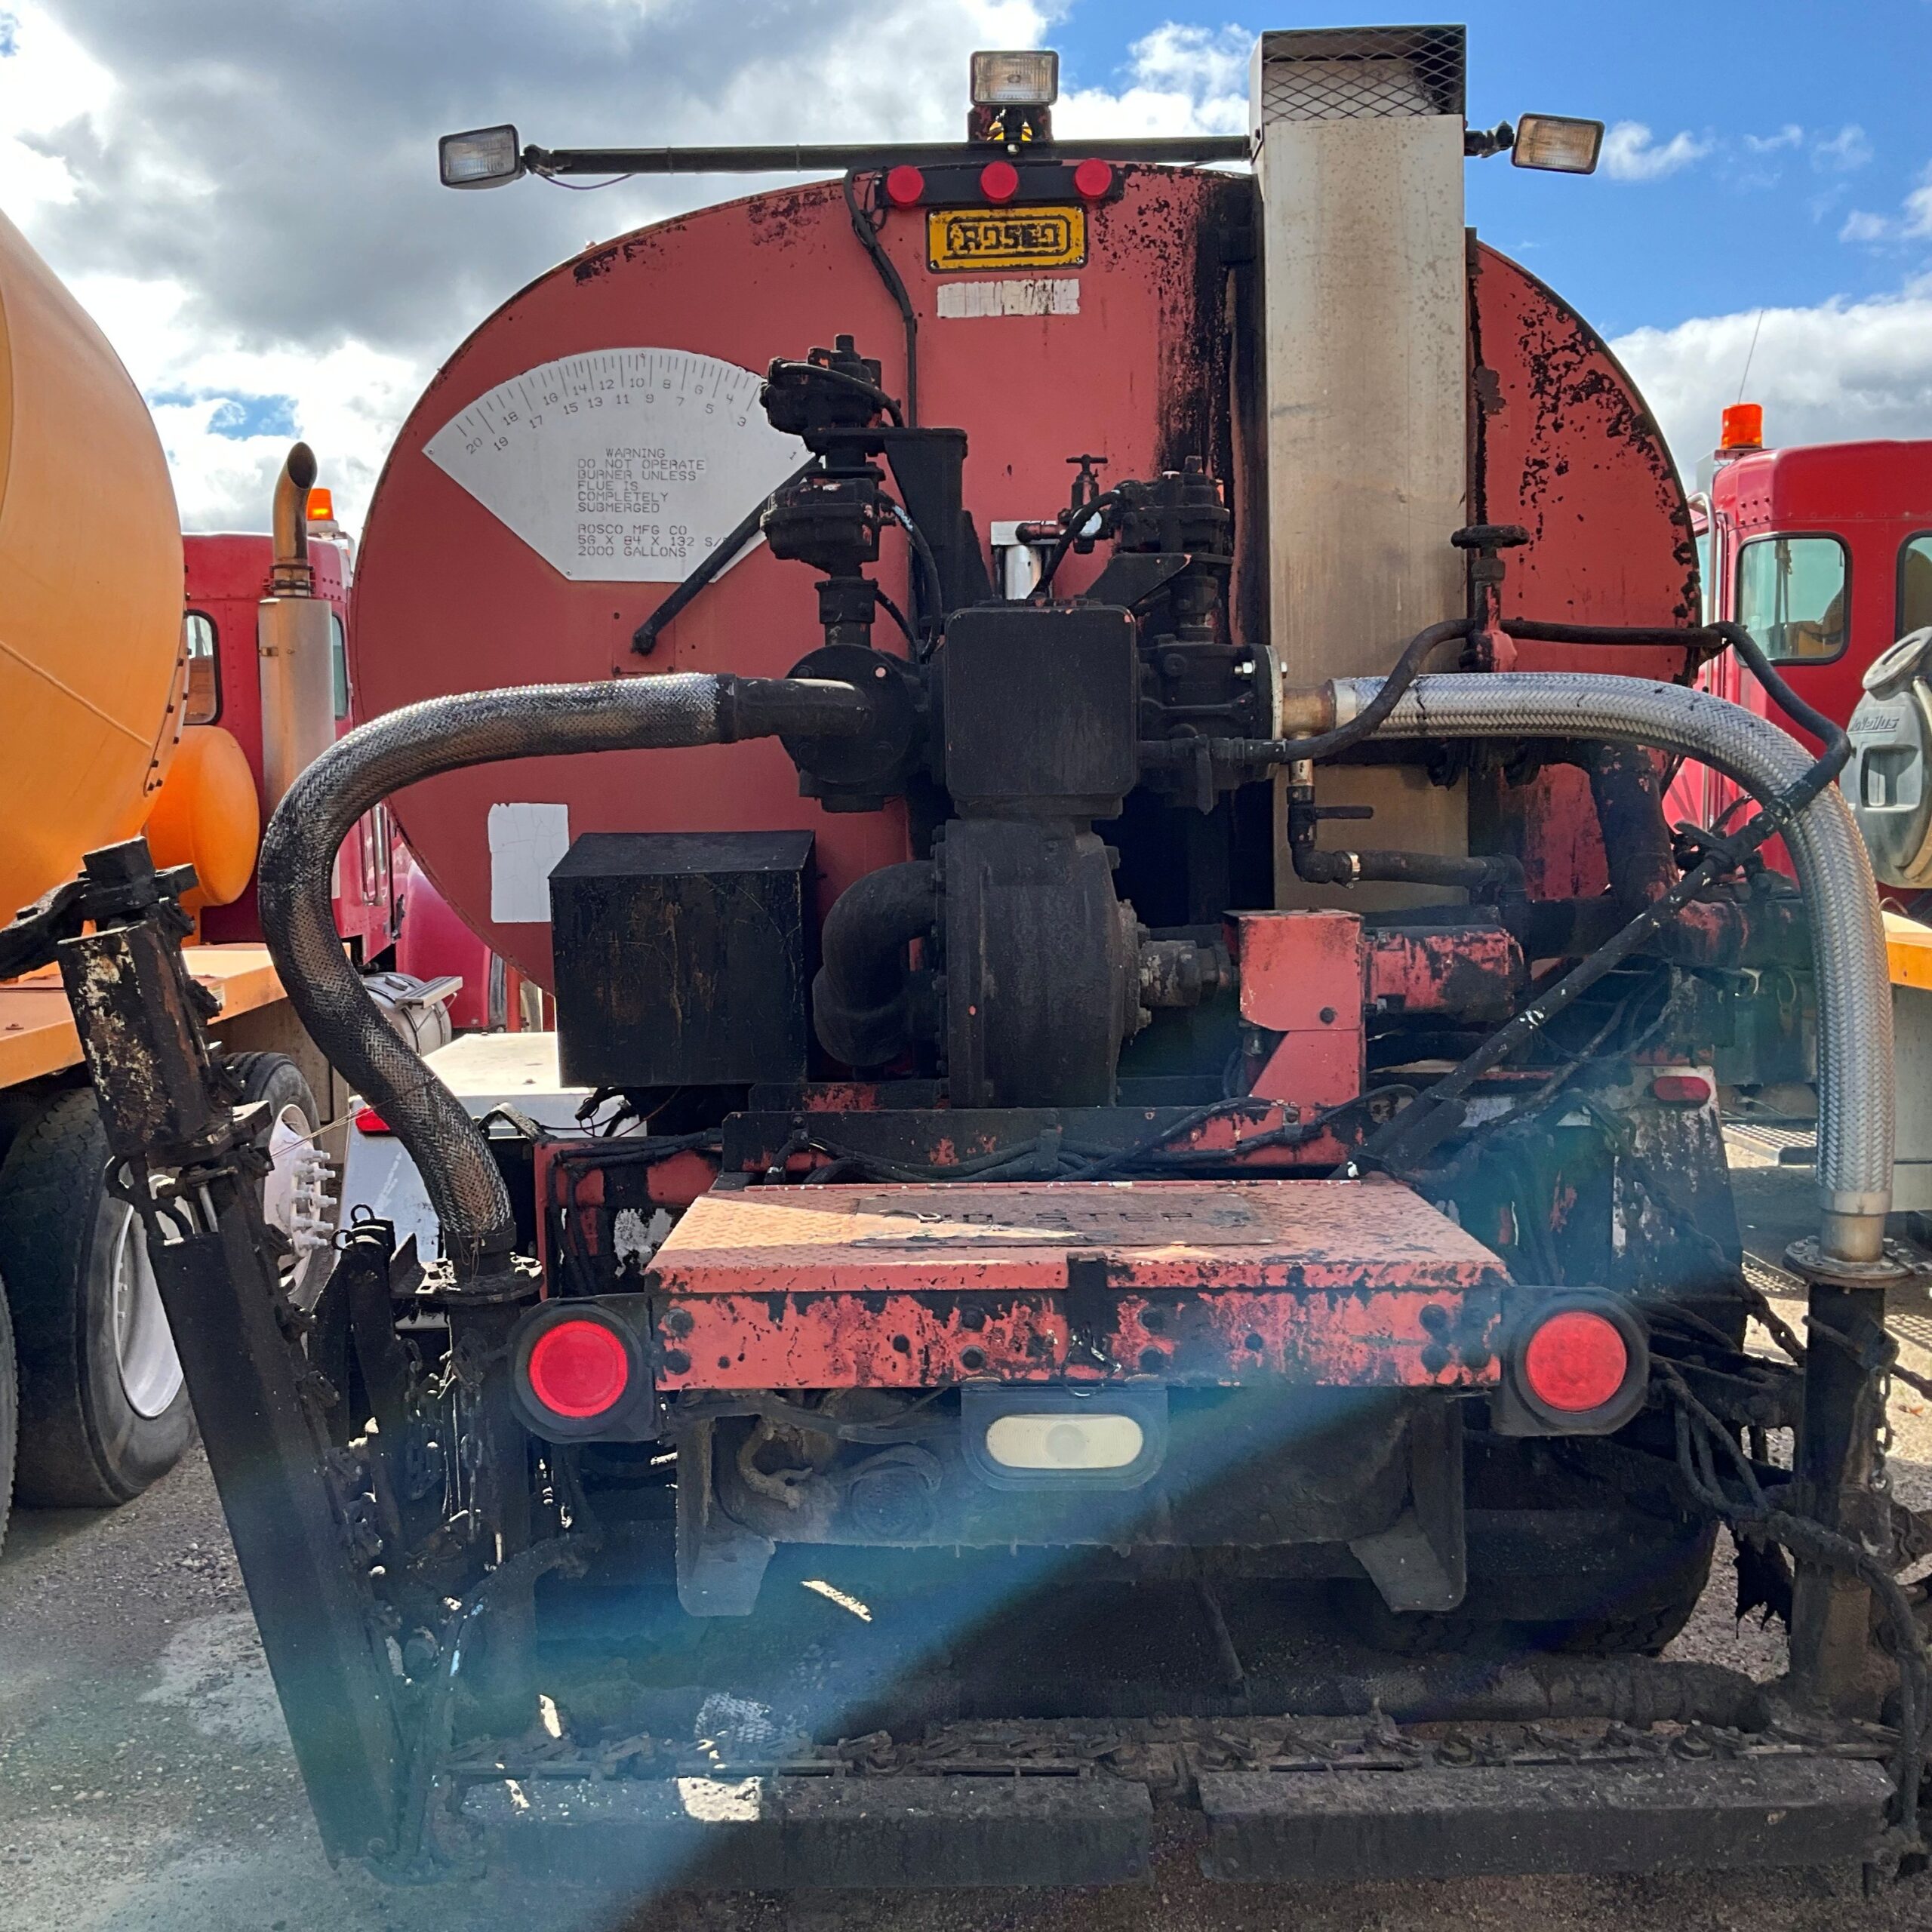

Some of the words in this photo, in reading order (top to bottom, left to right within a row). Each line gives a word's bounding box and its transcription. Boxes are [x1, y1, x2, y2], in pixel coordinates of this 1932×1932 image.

[599, 379, 615, 391] 12
[629, 378, 645, 388] 10
[663, 379, 671, 389] 8
[574, 383, 587, 396] 14
[588, 396, 603, 409] 13
[616, 394, 629, 405] 11
[645, 393, 654, 404] 9
[676, 396, 685, 406] 7
[726, 393, 734, 405] 4
[563, 402, 579, 415] 15
[705, 403, 714, 414] 5
[503, 411, 519, 426] 18
[529, 415, 543, 429] 17
[737, 417, 747, 427] 3
[466, 437, 484, 454] 20
[494, 436, 509, 451] 19
[605, 448, 666, 459] WARNING
[577, 459, 595, 469] DO
[605, 459, 632, 469] NOT
[641, 460, 706, 470] OPERATE
[577, 469, 632, 480] BURNER
[642, 470, 697, 481] UNLESS
[577, 481, 614, 491] FLUE
[623, 481, 638, 491] IS
[577, 491, 669, 502] COMPLETELY
[577, 503, 660, 513] SUBMERGED
[577, 524, 623, 534] ROSCO
[632, 525, 660, 535] MFG
[669, 525, 688, 535] CO
[605, 535, 614, 545] X
[651, 536, 660, 546] X
[671, 537, 695, 546] 132
[577, 546, 614, 556] 2000
[623, 547, 687, 558] GALLONS
[1035, 1212, 1193, 1223] STEP
